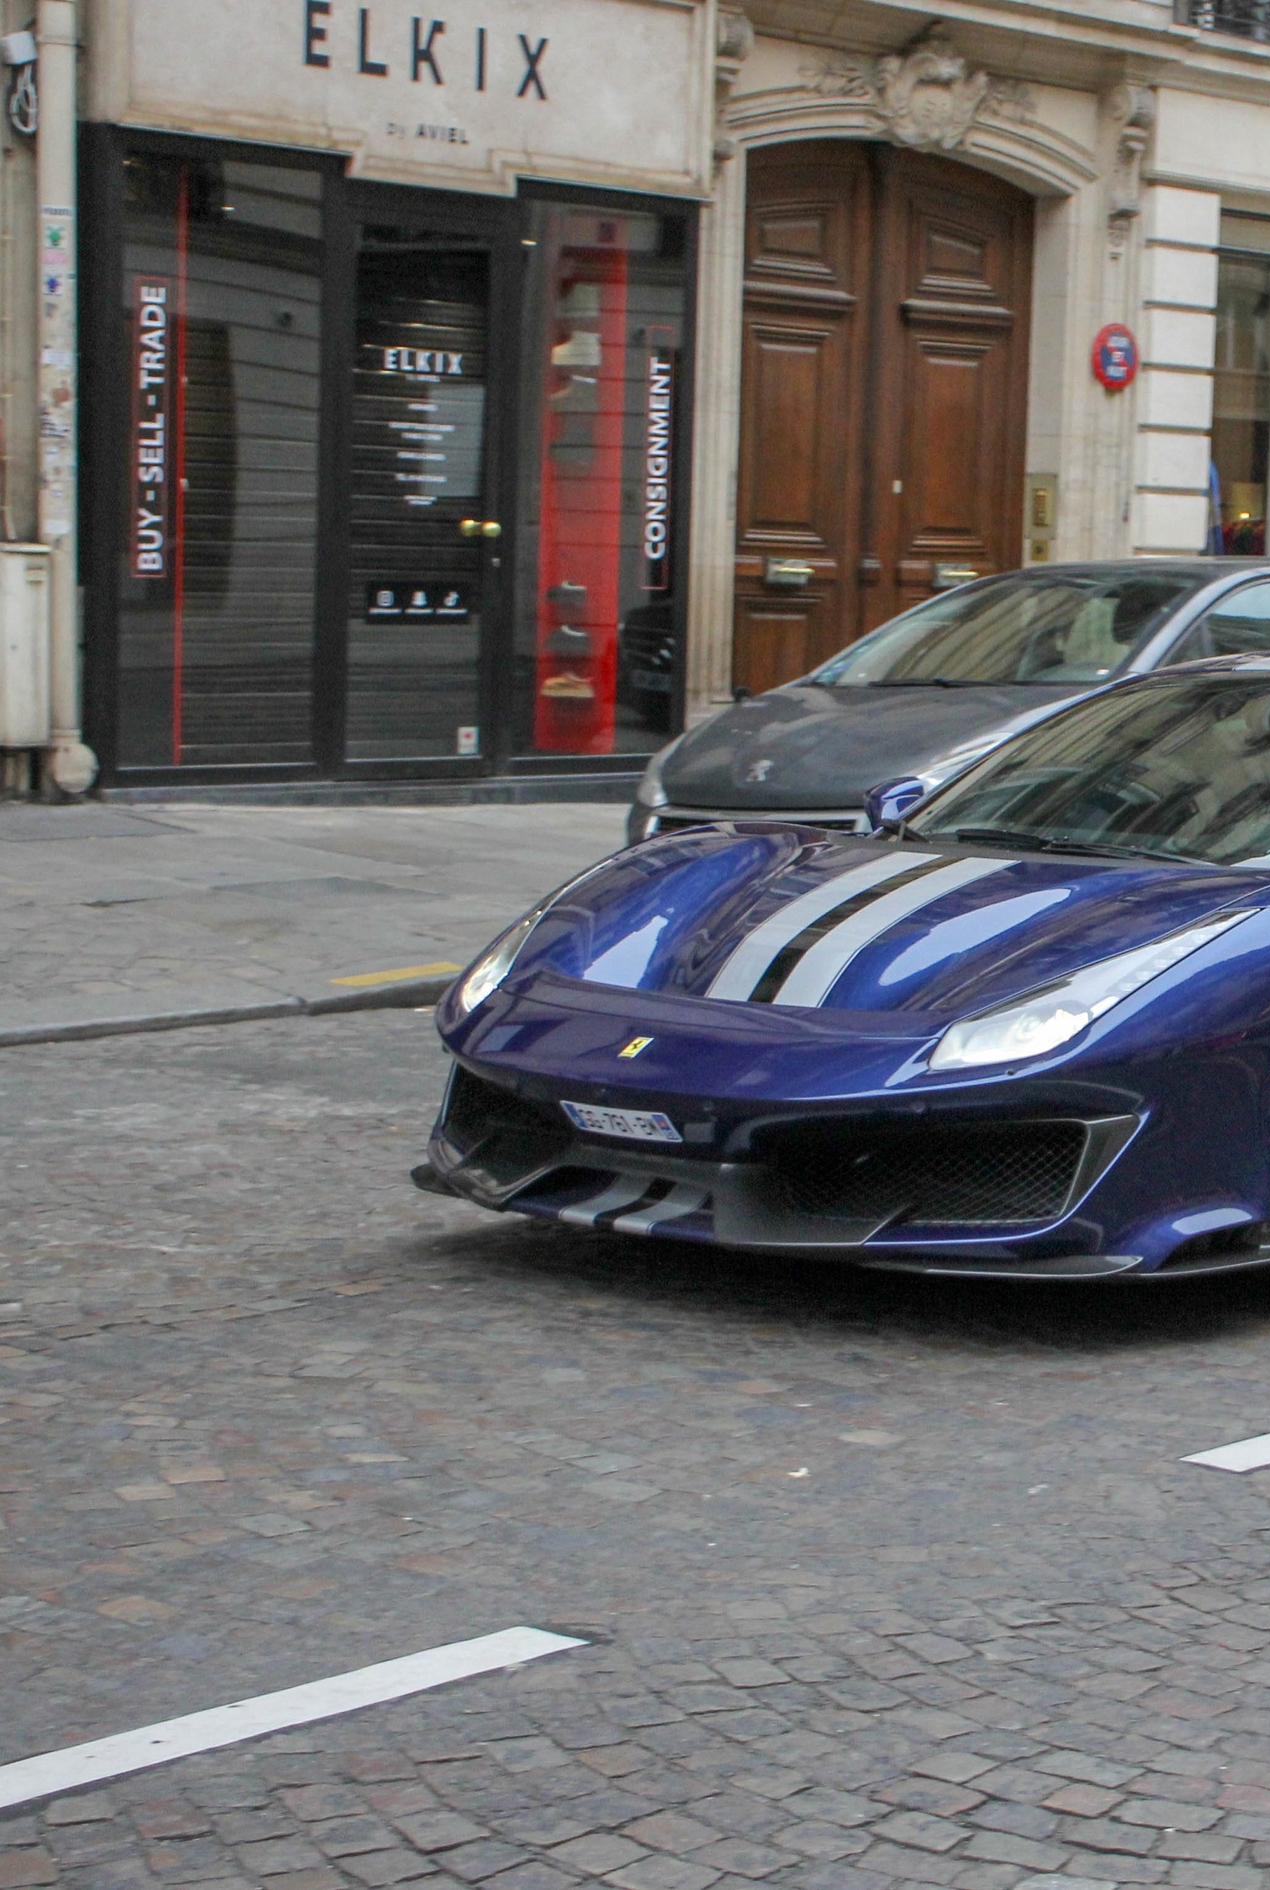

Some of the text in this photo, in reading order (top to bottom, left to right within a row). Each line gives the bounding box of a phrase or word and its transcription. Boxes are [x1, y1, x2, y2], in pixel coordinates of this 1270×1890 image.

[304, 0, 549, 101] ELKIX
[416, 124, 468, 145] AVIEL
[139, 286, 167, 388] TRADE
[384, 348, 464, 375] ELKIX
[138, 413, 165, 483] SELL
[645, 357, 672, 560] CONSIGNMENT
[138, 508, 164, 570] BUY
